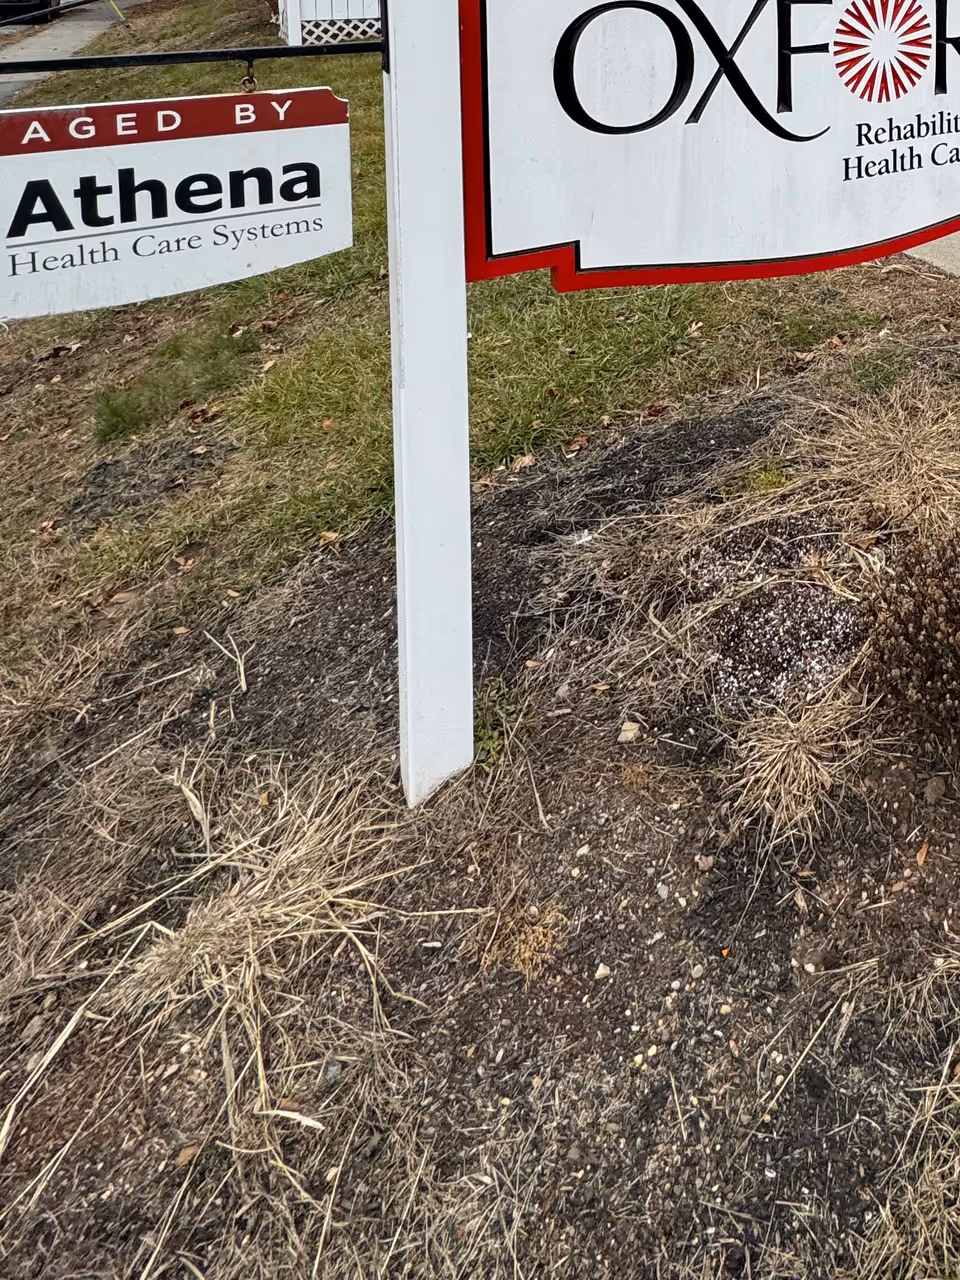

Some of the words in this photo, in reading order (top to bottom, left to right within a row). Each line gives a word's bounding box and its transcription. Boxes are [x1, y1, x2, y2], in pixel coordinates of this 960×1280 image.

[235, 100, 293, 125] BY
[843, 146, 923, 181] Health
[6, 161, 321, 239] Athena
[8, 241, 120, 277] Health
[132, 233, 202, 258] Care
[212, 216, 323, 250] Systems
